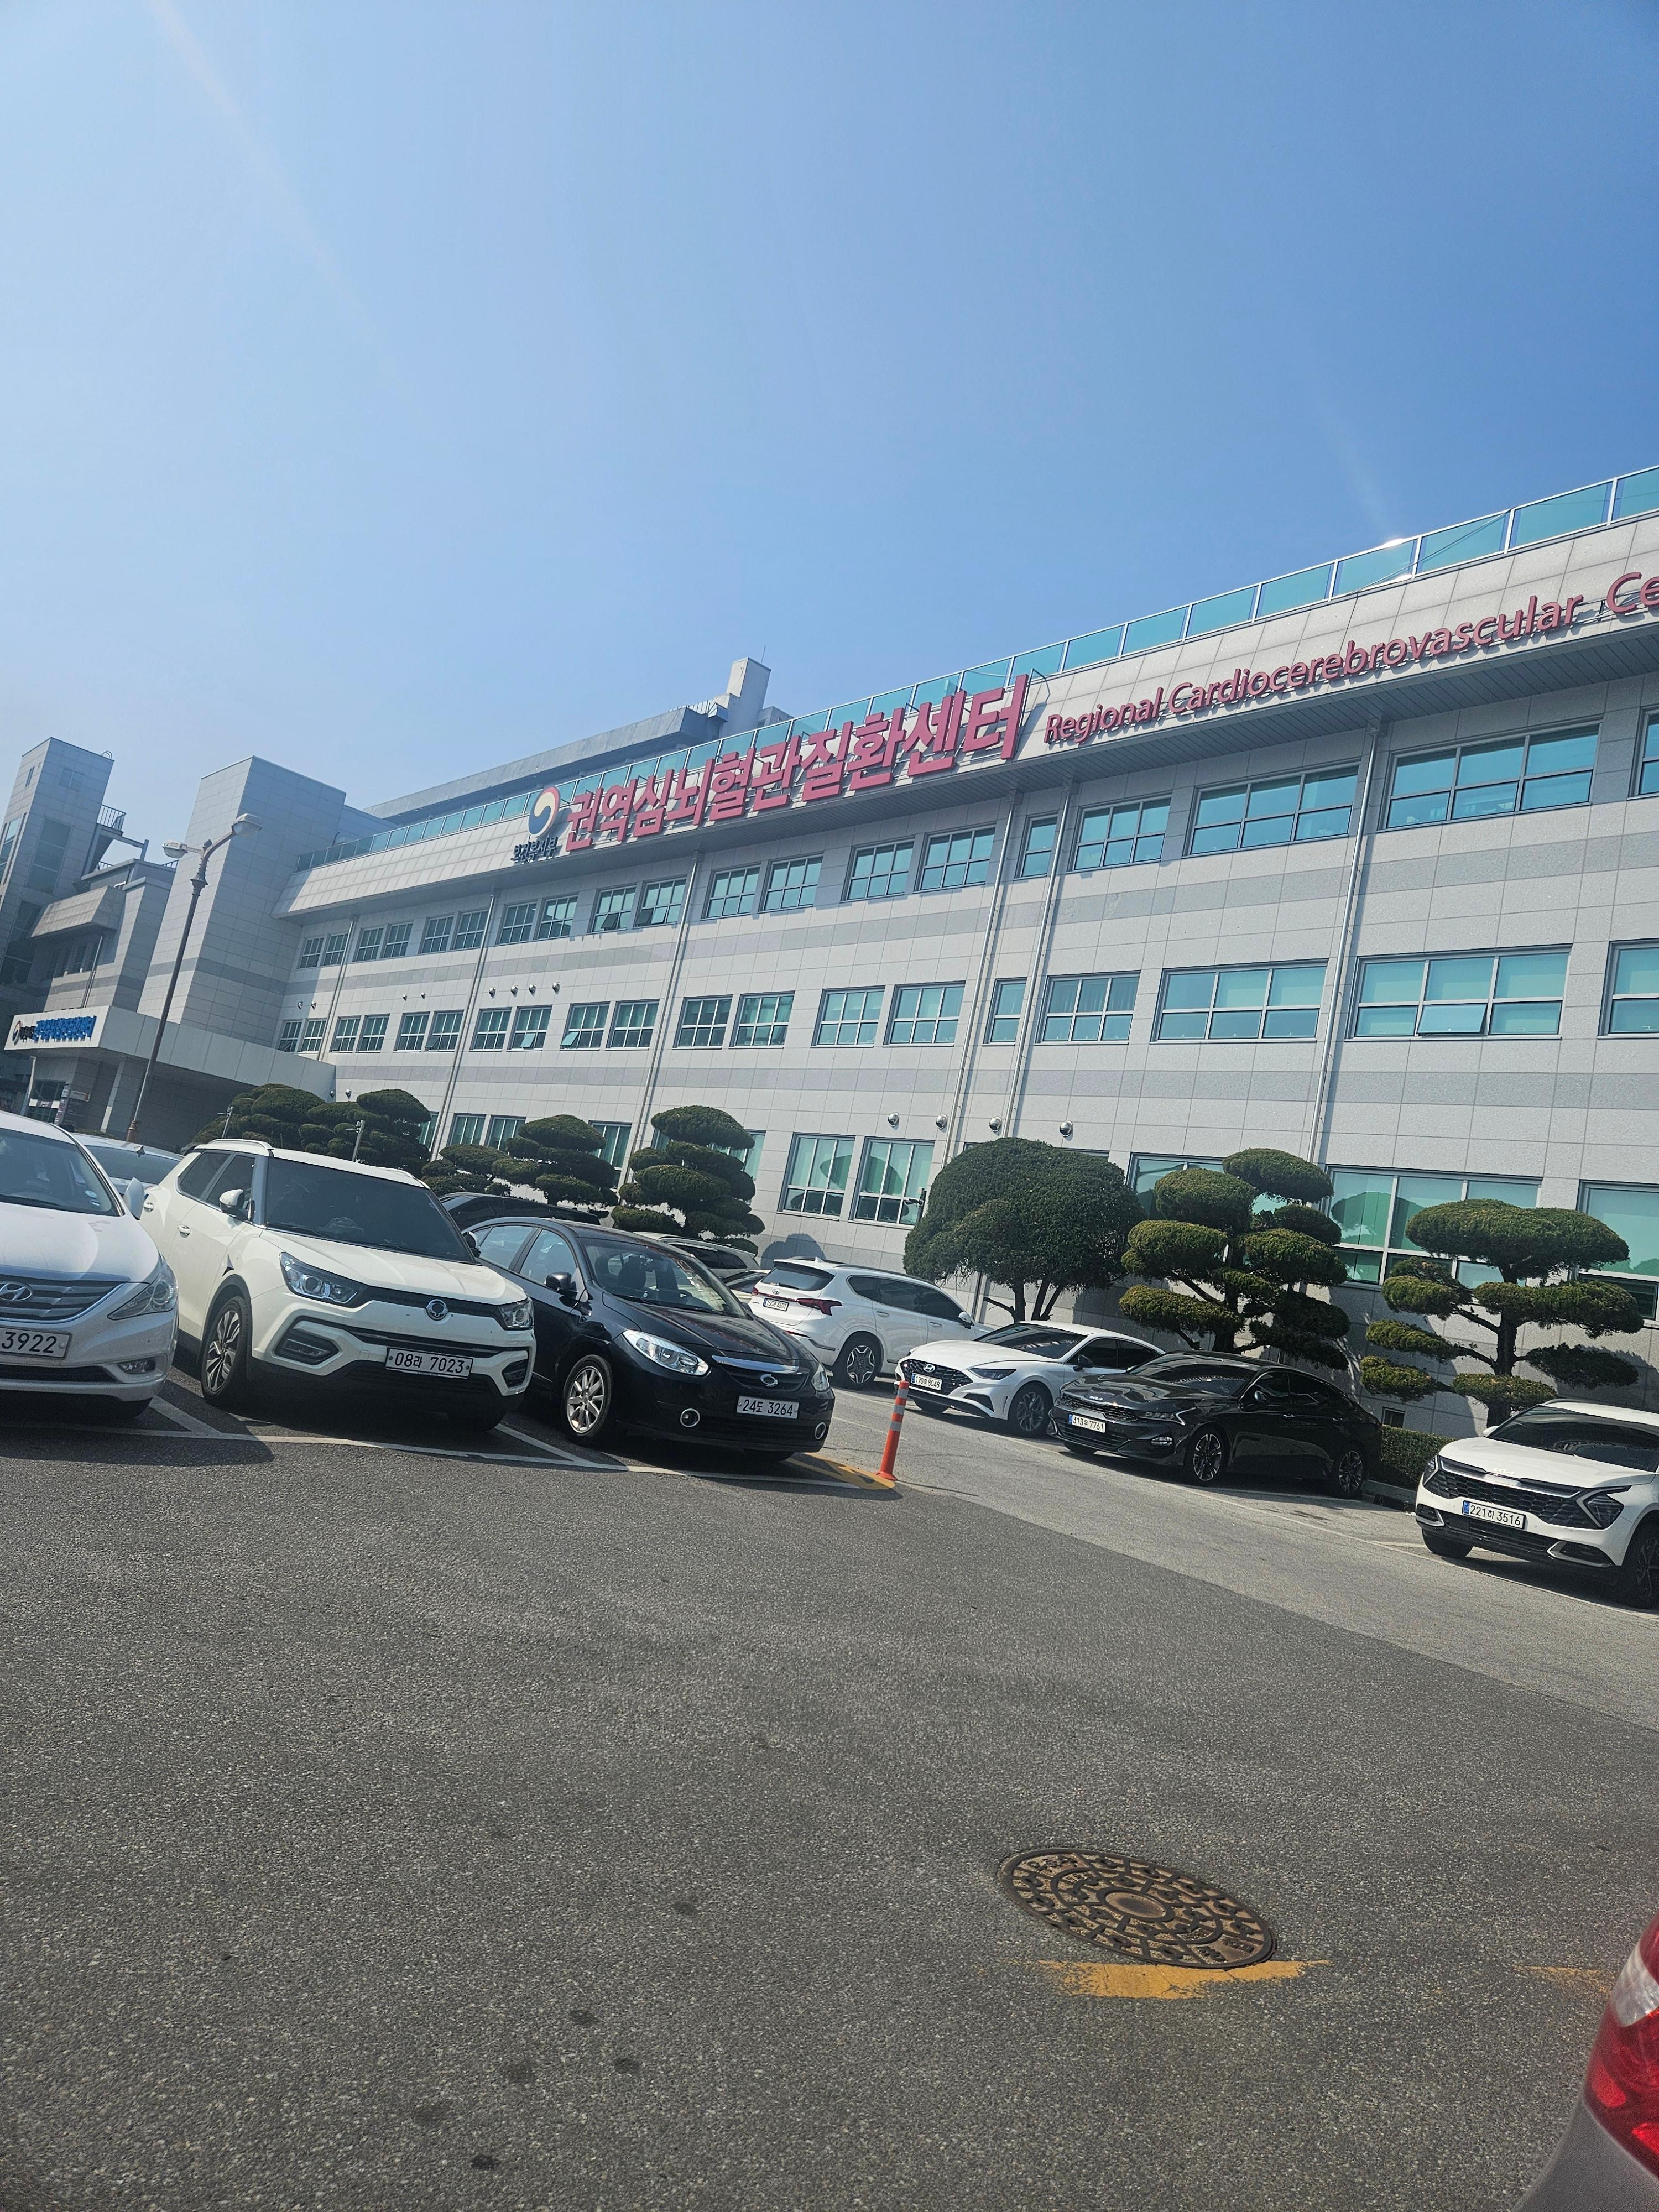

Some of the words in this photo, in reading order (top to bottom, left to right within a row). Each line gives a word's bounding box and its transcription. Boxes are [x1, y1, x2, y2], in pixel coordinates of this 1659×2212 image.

[1044, 687, 1164, 743] Regional
[1168, 594, 1584, 713] Cardiocerebrovascular
[565, 674, 1029, 851] 권역심뇌혈관질환센터
[1, 1332, 58, 1353] 3922
[394, 1352, 422, 1368] 08라
[430, 1357, 465, 1373] 7023
[928, 1379, 940, 1388] 8048
[743, 1399, 763, 1412] 24도
[768, 1402, 793, 1416] 3264
[1073, 1416, 1088, 1426] 313우
[1089, 1420, 1103, 1431] 7761
[1470, 1505, 1494, 1519] 221하
[1496, 1511, 1521, 1526] 3516
